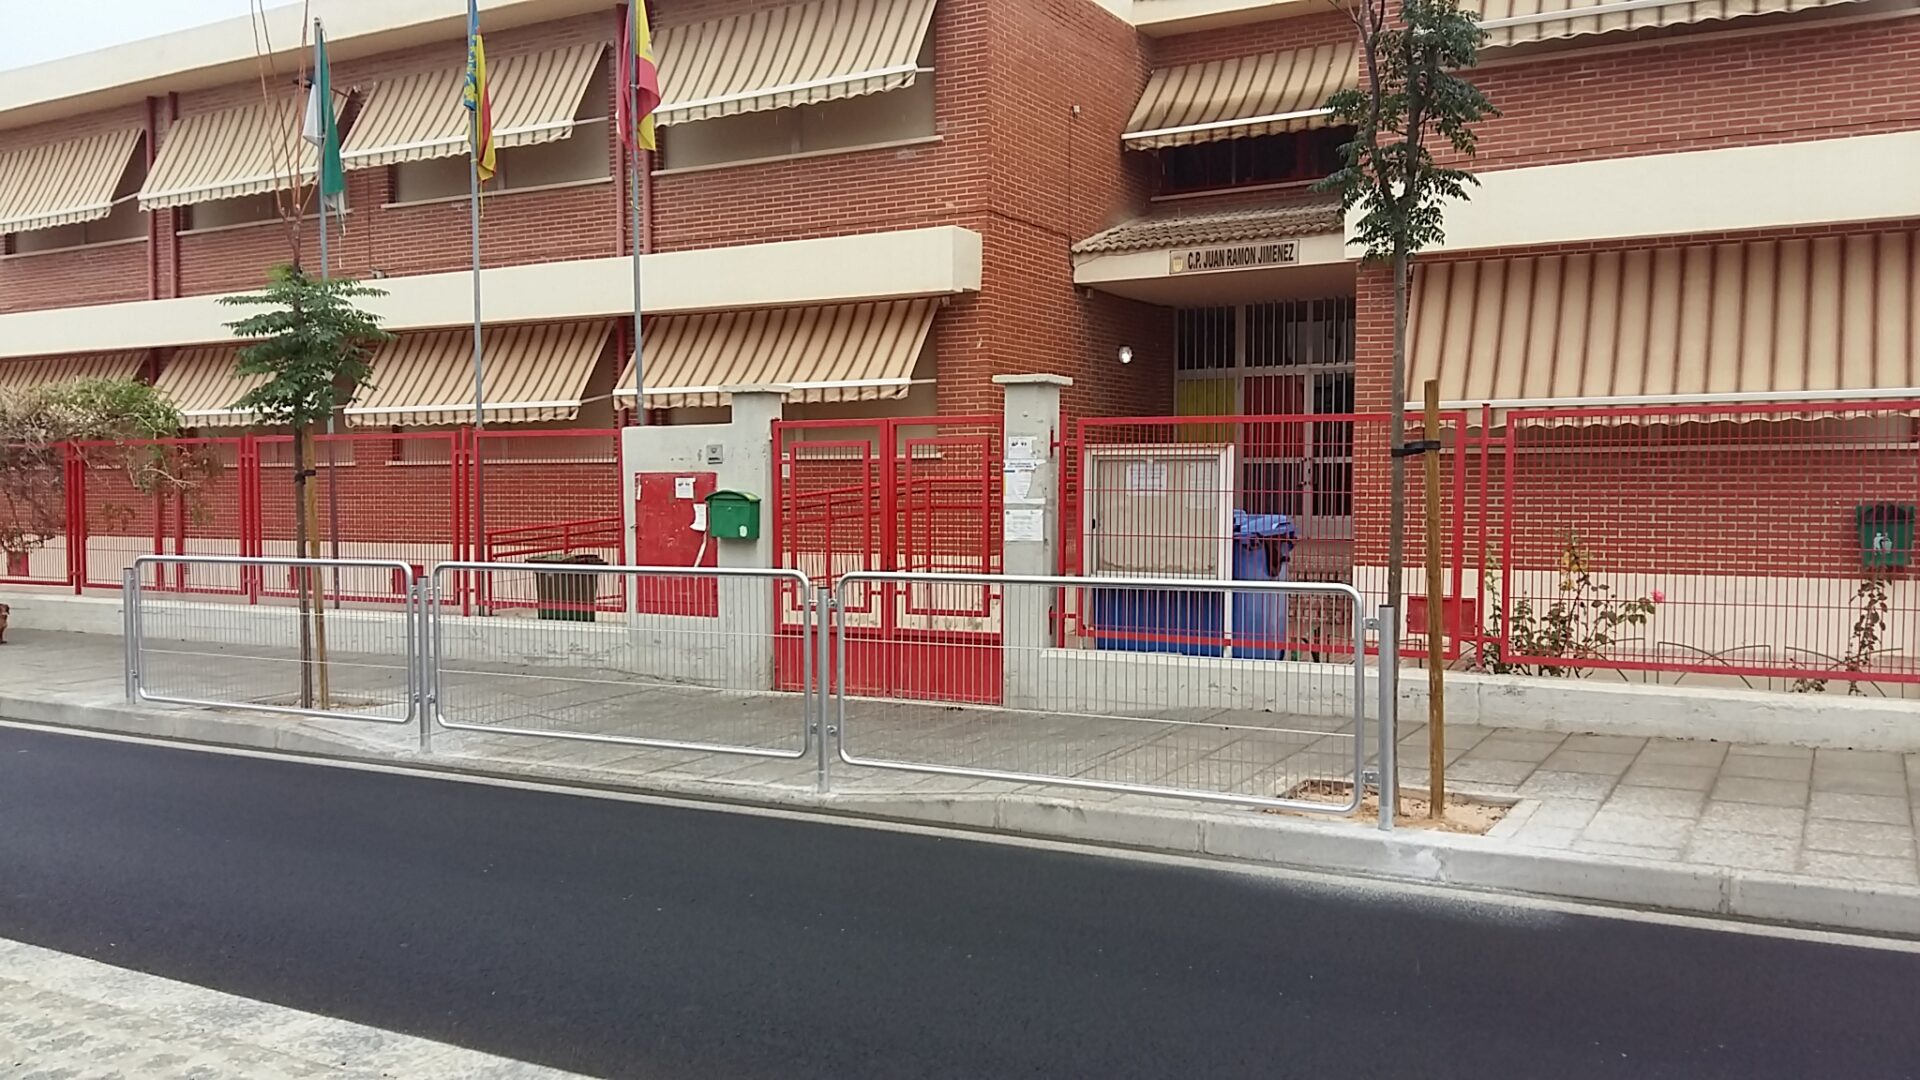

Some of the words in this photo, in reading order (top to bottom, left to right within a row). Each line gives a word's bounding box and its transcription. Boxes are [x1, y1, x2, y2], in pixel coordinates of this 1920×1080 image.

[1188, 252, 1201, 269] C.P.
[1203, 250, 1225, 268] JUAN
[1227, 247, 1256, 265] RAMON
[1258, 243, 1294, 263] JIMENEZ
